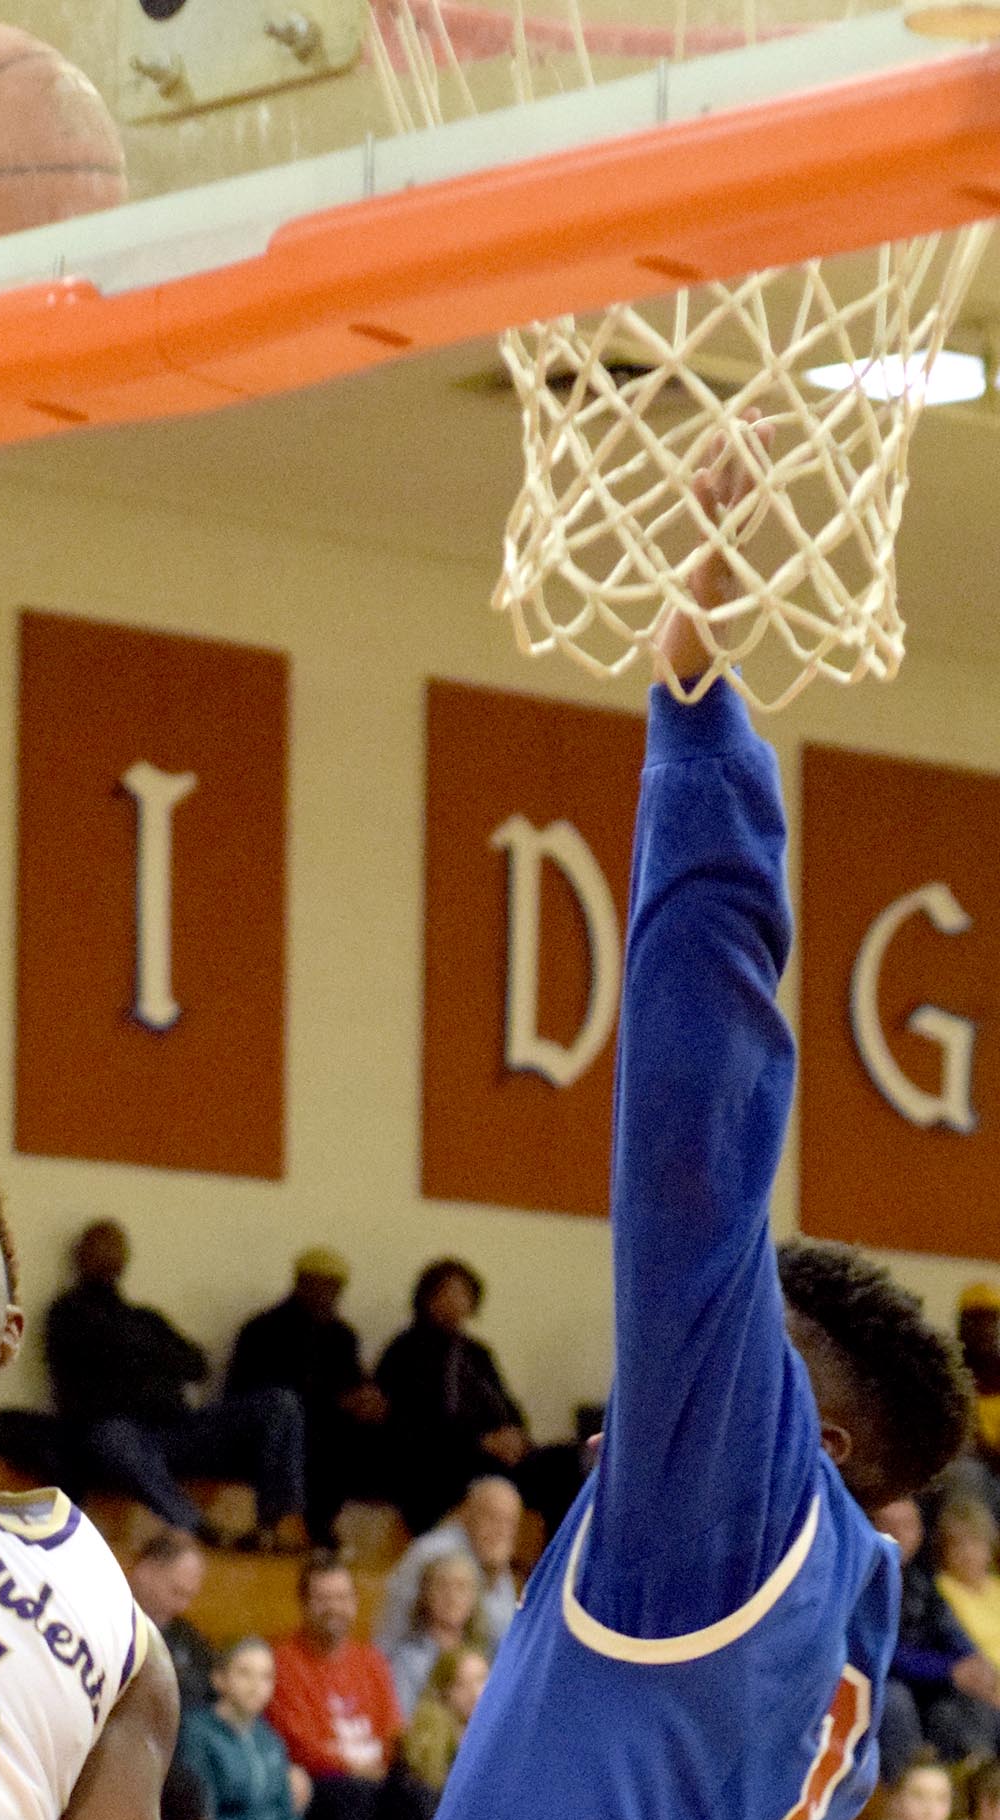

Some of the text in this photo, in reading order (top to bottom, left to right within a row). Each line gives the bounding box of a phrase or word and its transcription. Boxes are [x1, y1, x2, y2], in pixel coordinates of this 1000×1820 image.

[121, 760, 198, 1031] I
[490, 813, 621, 1088] D
[849, 882, 978, 1134] G
